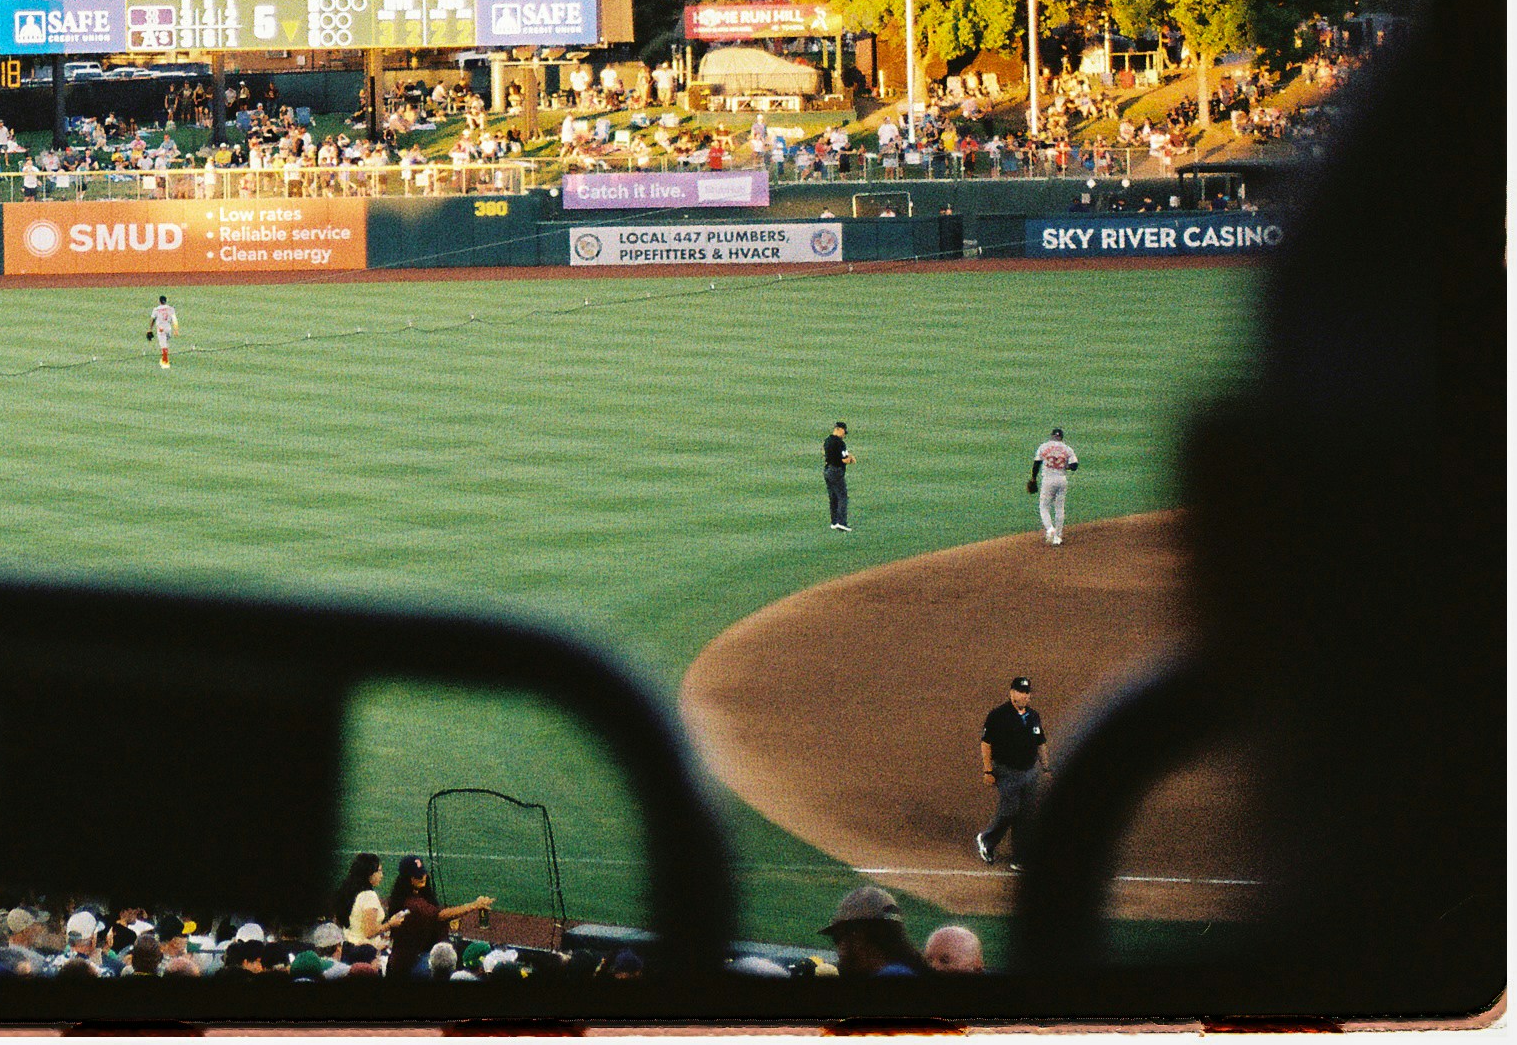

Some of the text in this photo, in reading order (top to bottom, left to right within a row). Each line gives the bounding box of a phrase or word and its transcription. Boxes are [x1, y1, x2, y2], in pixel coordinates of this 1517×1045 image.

[47, 10, 110, 33] SAFE
[523, 2, 582, 25] SAFE
[740, 9, 771, 24] RUN
[773, 8, 805, 22] HILL
[48, 34, 111, 42] CREDIT UNION
[577, 181, 686, 199] Catch it live.
[220, 207, 302, 221] Low rates
[69, 222, 183, 252] SMUD
[220, 226, 352, 242] Reliable service
[619, 229, 791, 244] LOCAL 447 PLUMBERS,
[1041, 225, 1283, 250] SKY RIVER CASINO
[220, 245, 332, 264] Clean energy
[620, 246, 781, 261] PIPEFITTERS & HVACR
